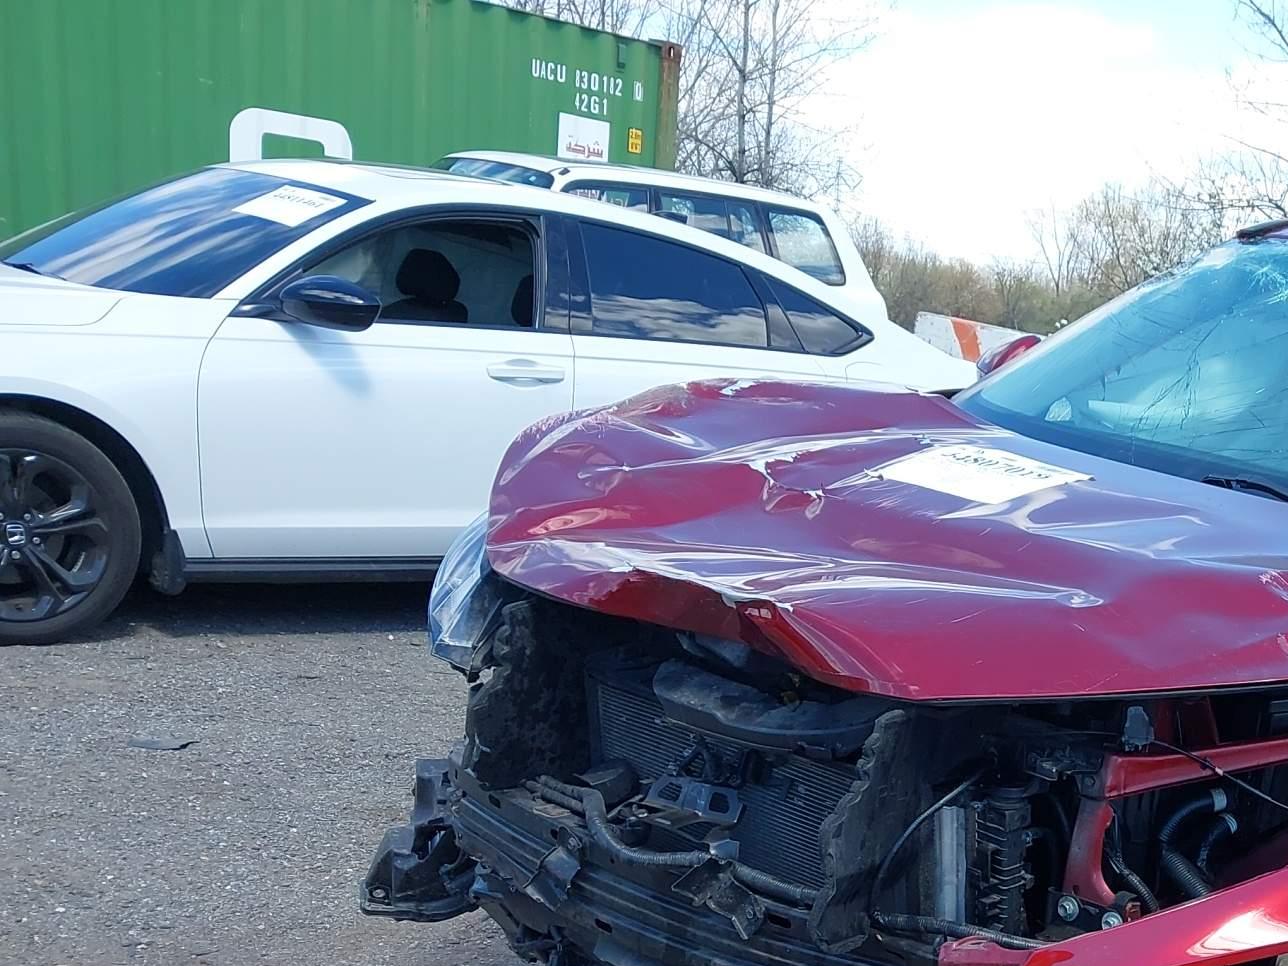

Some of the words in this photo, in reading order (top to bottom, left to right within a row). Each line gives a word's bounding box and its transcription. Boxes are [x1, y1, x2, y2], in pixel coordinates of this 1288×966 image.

[531, 58, 567, 83] UACU
[575, 69, 623, 97] 830182
[574, 92, 608, 116] 42G1
